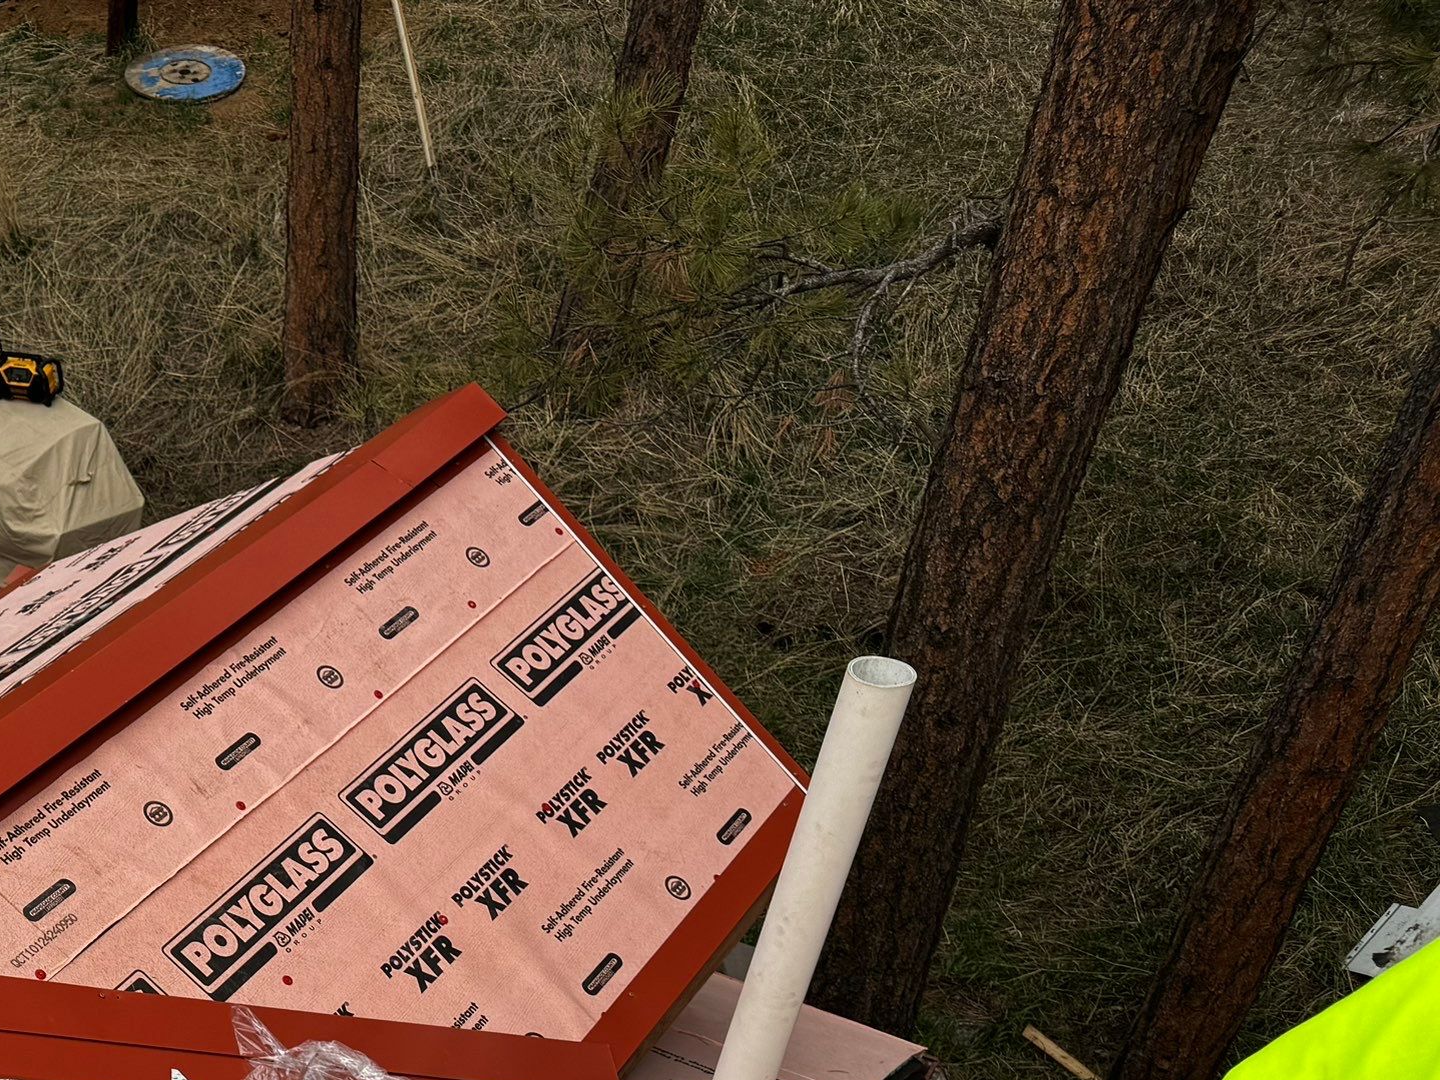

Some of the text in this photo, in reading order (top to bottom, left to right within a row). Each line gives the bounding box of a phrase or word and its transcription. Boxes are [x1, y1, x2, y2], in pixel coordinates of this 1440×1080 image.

[344, 551, 388, 587] Self-Adhered
[373, 564, 394, 582] Temp
[506, 574, 625, 685] POLYGLASS
[589, 635, 610, 658] MAPEI
[180, 635, 278, 711] Self-Adhered Fire-Resistant
[192, 647, 287, 720] High Temp Underlayment
[355, 692, 497, 821] POLYGLASS
[595, 709, 650, 766] POLYSTICK
[616, 729, 666, 779] XFR
[43, 769, 103, 815] Fire-Resistant
[447, 761, 475, 787] MAPEI
[0, 780, 112, 866] High Temp Underlayment
[555, 787, 608, 838] XFR
[179, 828, 344, 978] POLYGLASS
[450, 844, 514, 908] POLYSTICK
[474, 867, 530, 921] XFR
[541, 847, 625, 935] Self-Adhered Fire-Resistant
[554, 858, 635, 943] High Temp Underlayment
[286, 907, 316, 938] MAPEI
[380, 911, 441, 980] POLYSTICK
[404, 936, 463, 994] XFR
